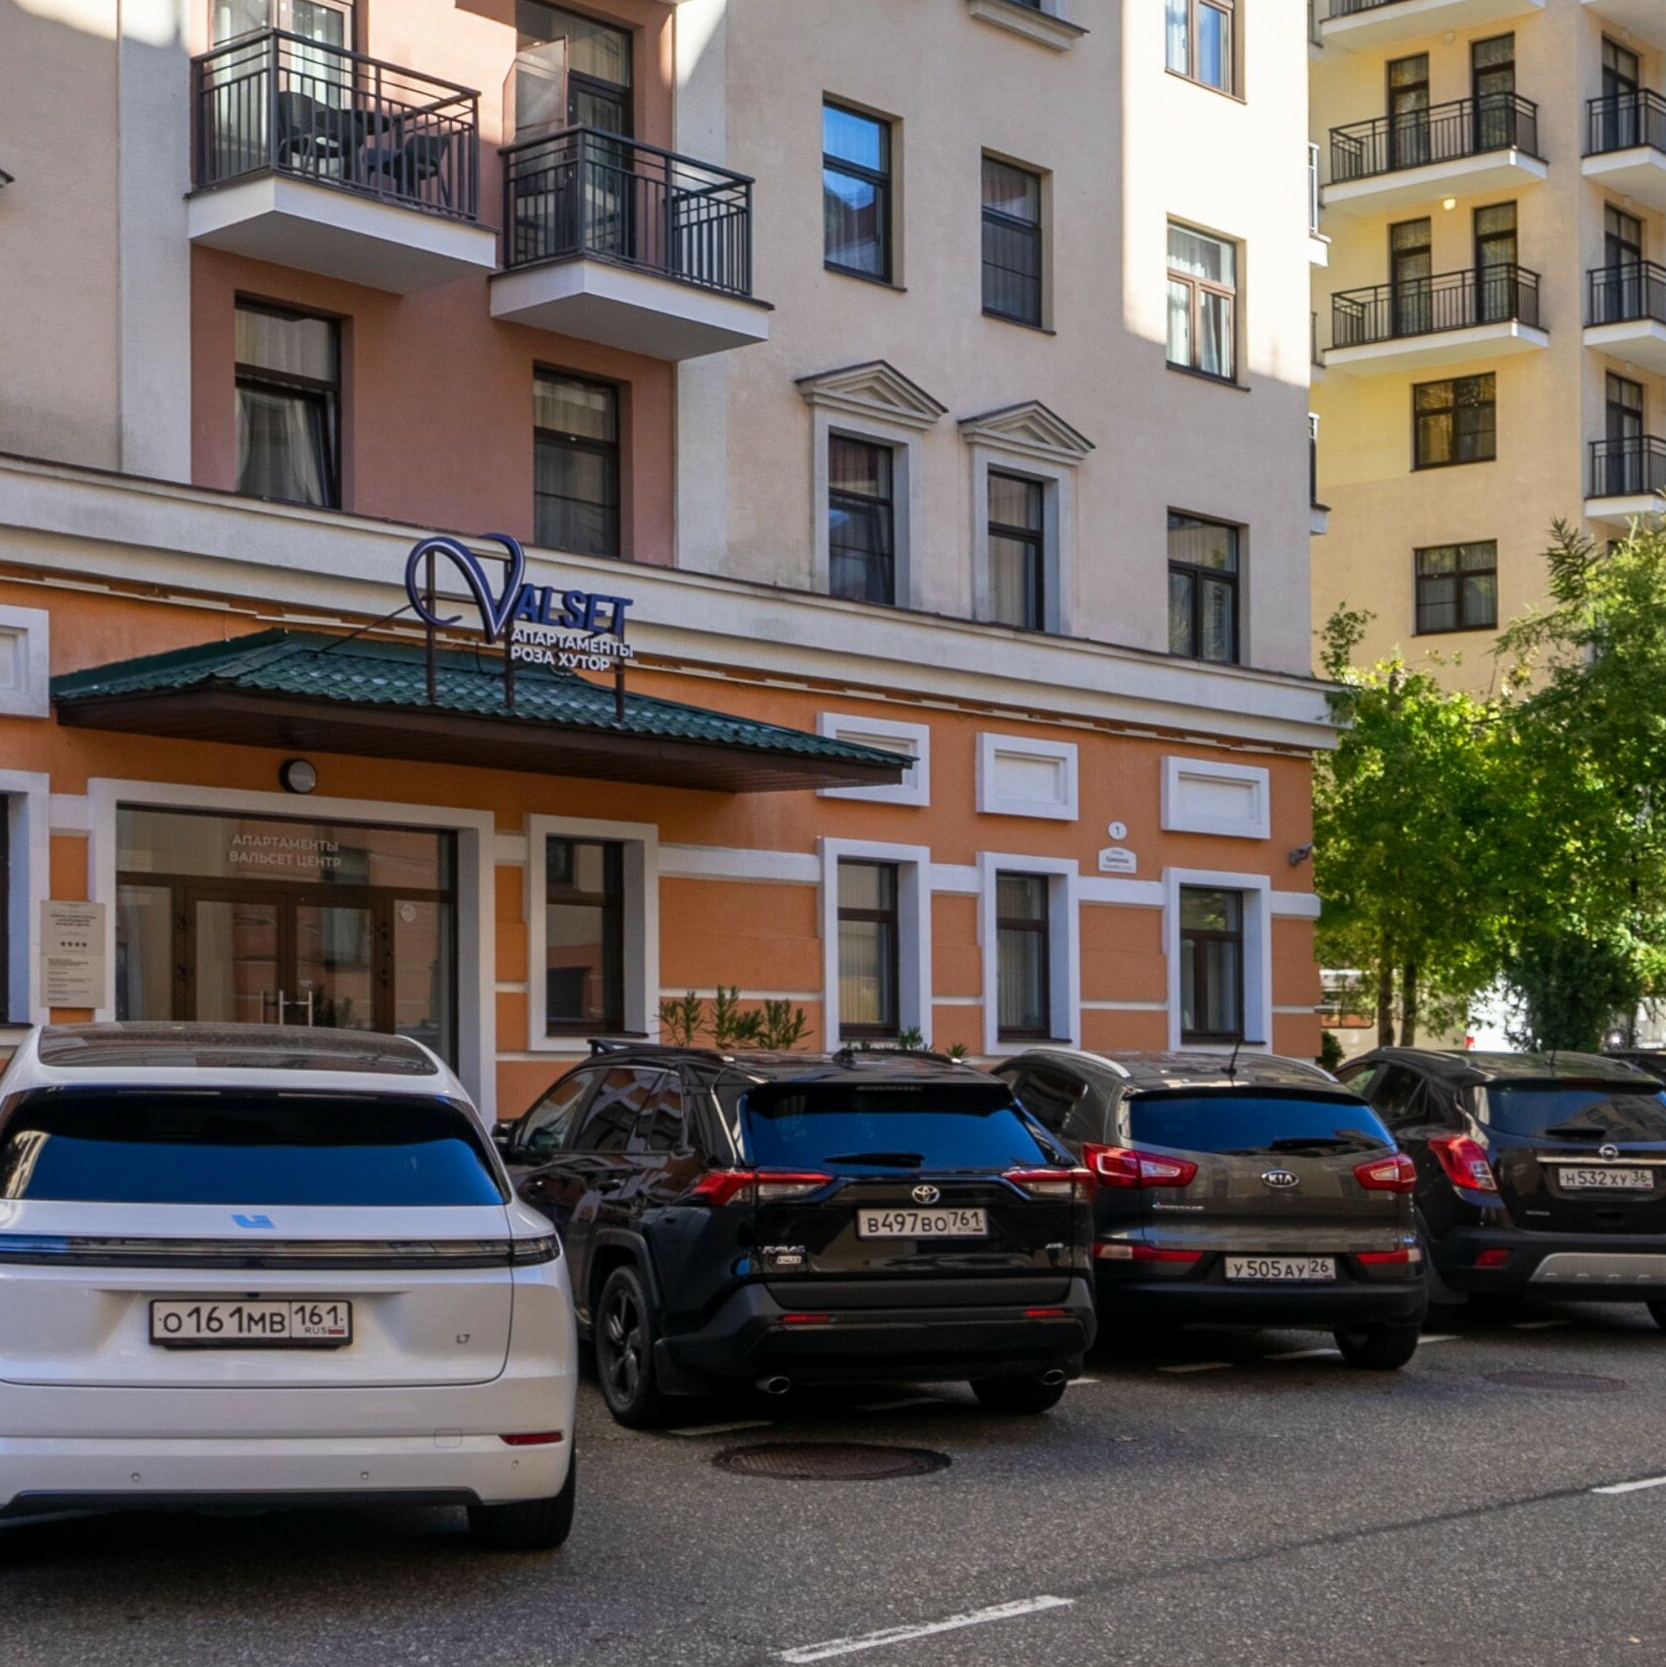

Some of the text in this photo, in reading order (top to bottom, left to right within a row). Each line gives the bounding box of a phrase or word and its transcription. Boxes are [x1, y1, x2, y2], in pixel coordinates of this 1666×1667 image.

[405, 533, 633, 645] VALSET
[511, 629, 633, 658] АПАРТАМЕНТЫ
[510, 645, 611, 672] РОЗА ХУТОР
[232, 834, 339, 852] АПАРТАМЕНТЫ
[229, 850, 342, 869] ВАЛЬСЕТ ЦЕНТР
[1268, 1173, 1293, 1183] KIA
[950, 1211, 981, 1227] 761
[1310, 1259, 1330, 1274] 26
[294, 1304, 339, 1326] 161
[304, 1326, 327, 1335] RUS
[456, 1333, 471, 1344] L7
